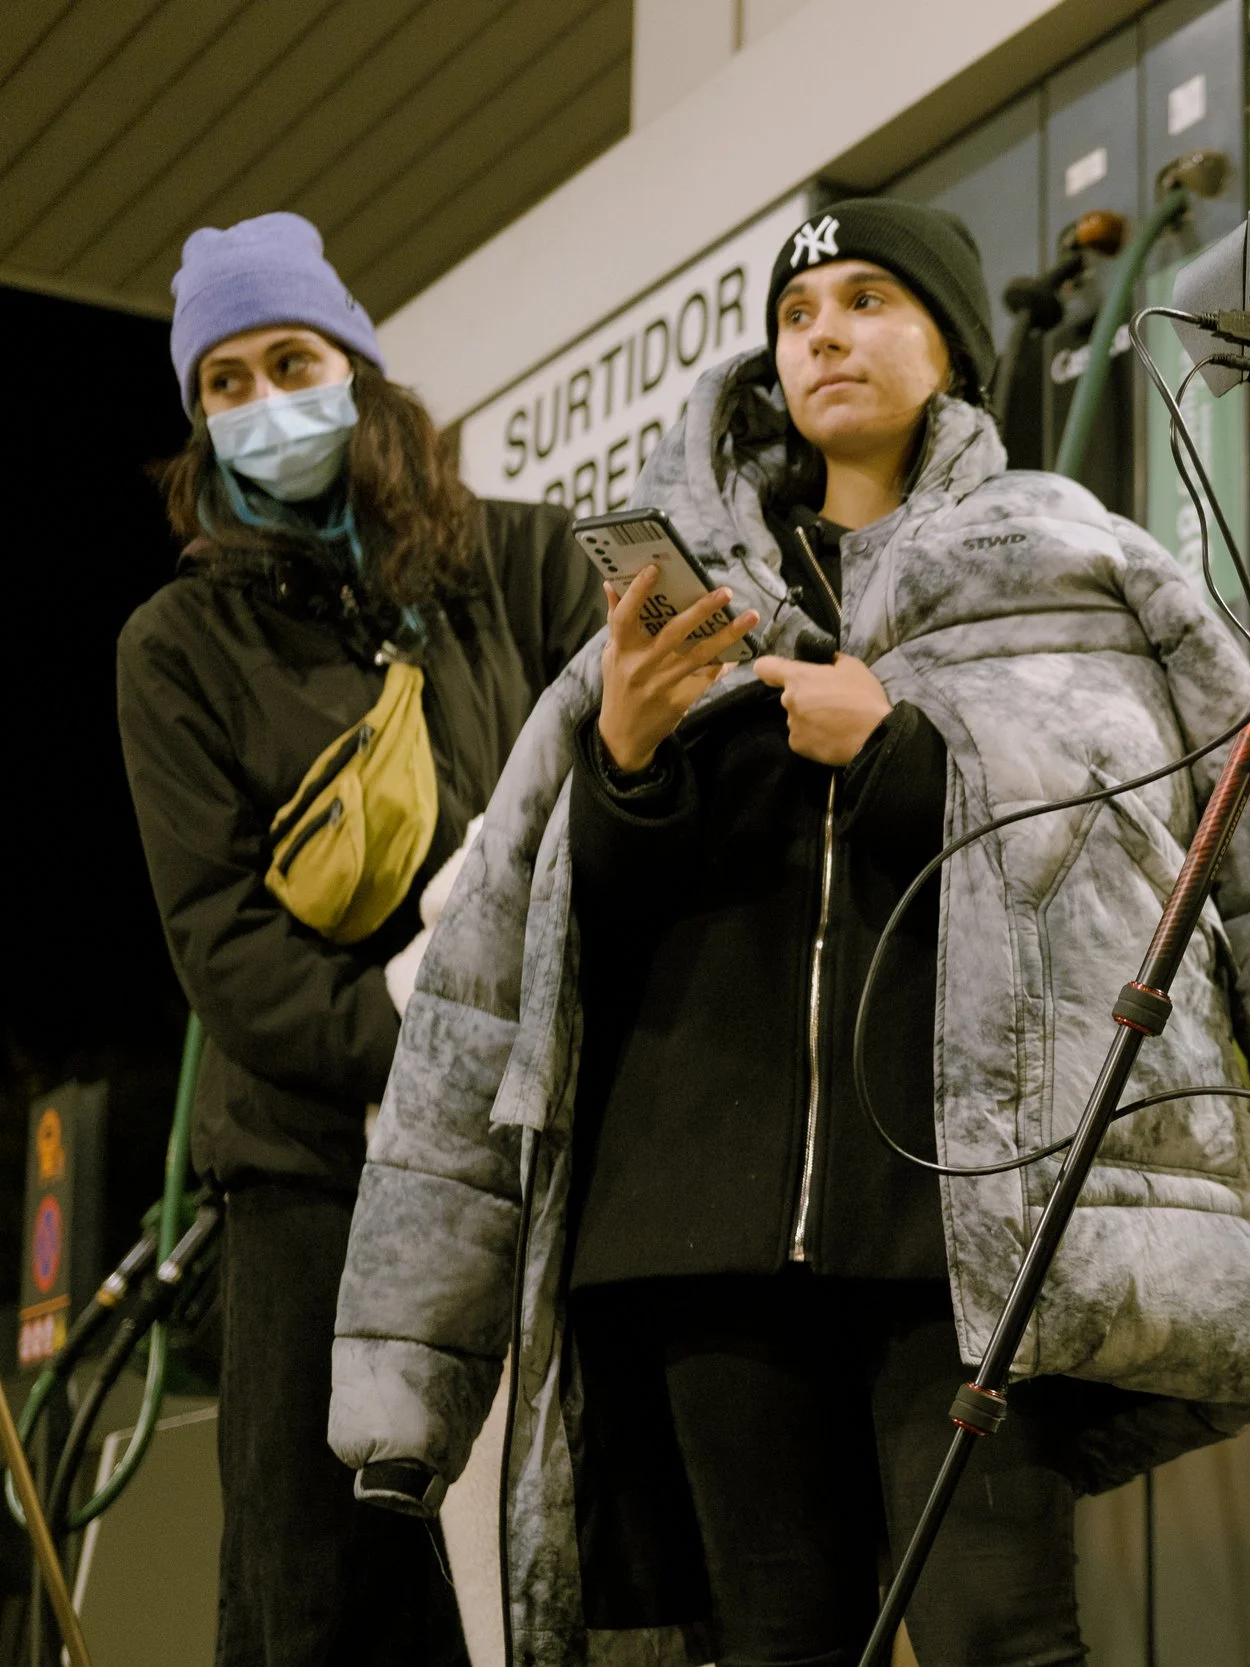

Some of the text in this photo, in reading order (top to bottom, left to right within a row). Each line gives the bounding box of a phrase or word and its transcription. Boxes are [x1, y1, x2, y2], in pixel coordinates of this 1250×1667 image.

[790, 215, 840, 269] NY
[503, 264, 746, 481] SURTIDOR
[962, 533, 1027, 551] STWD
